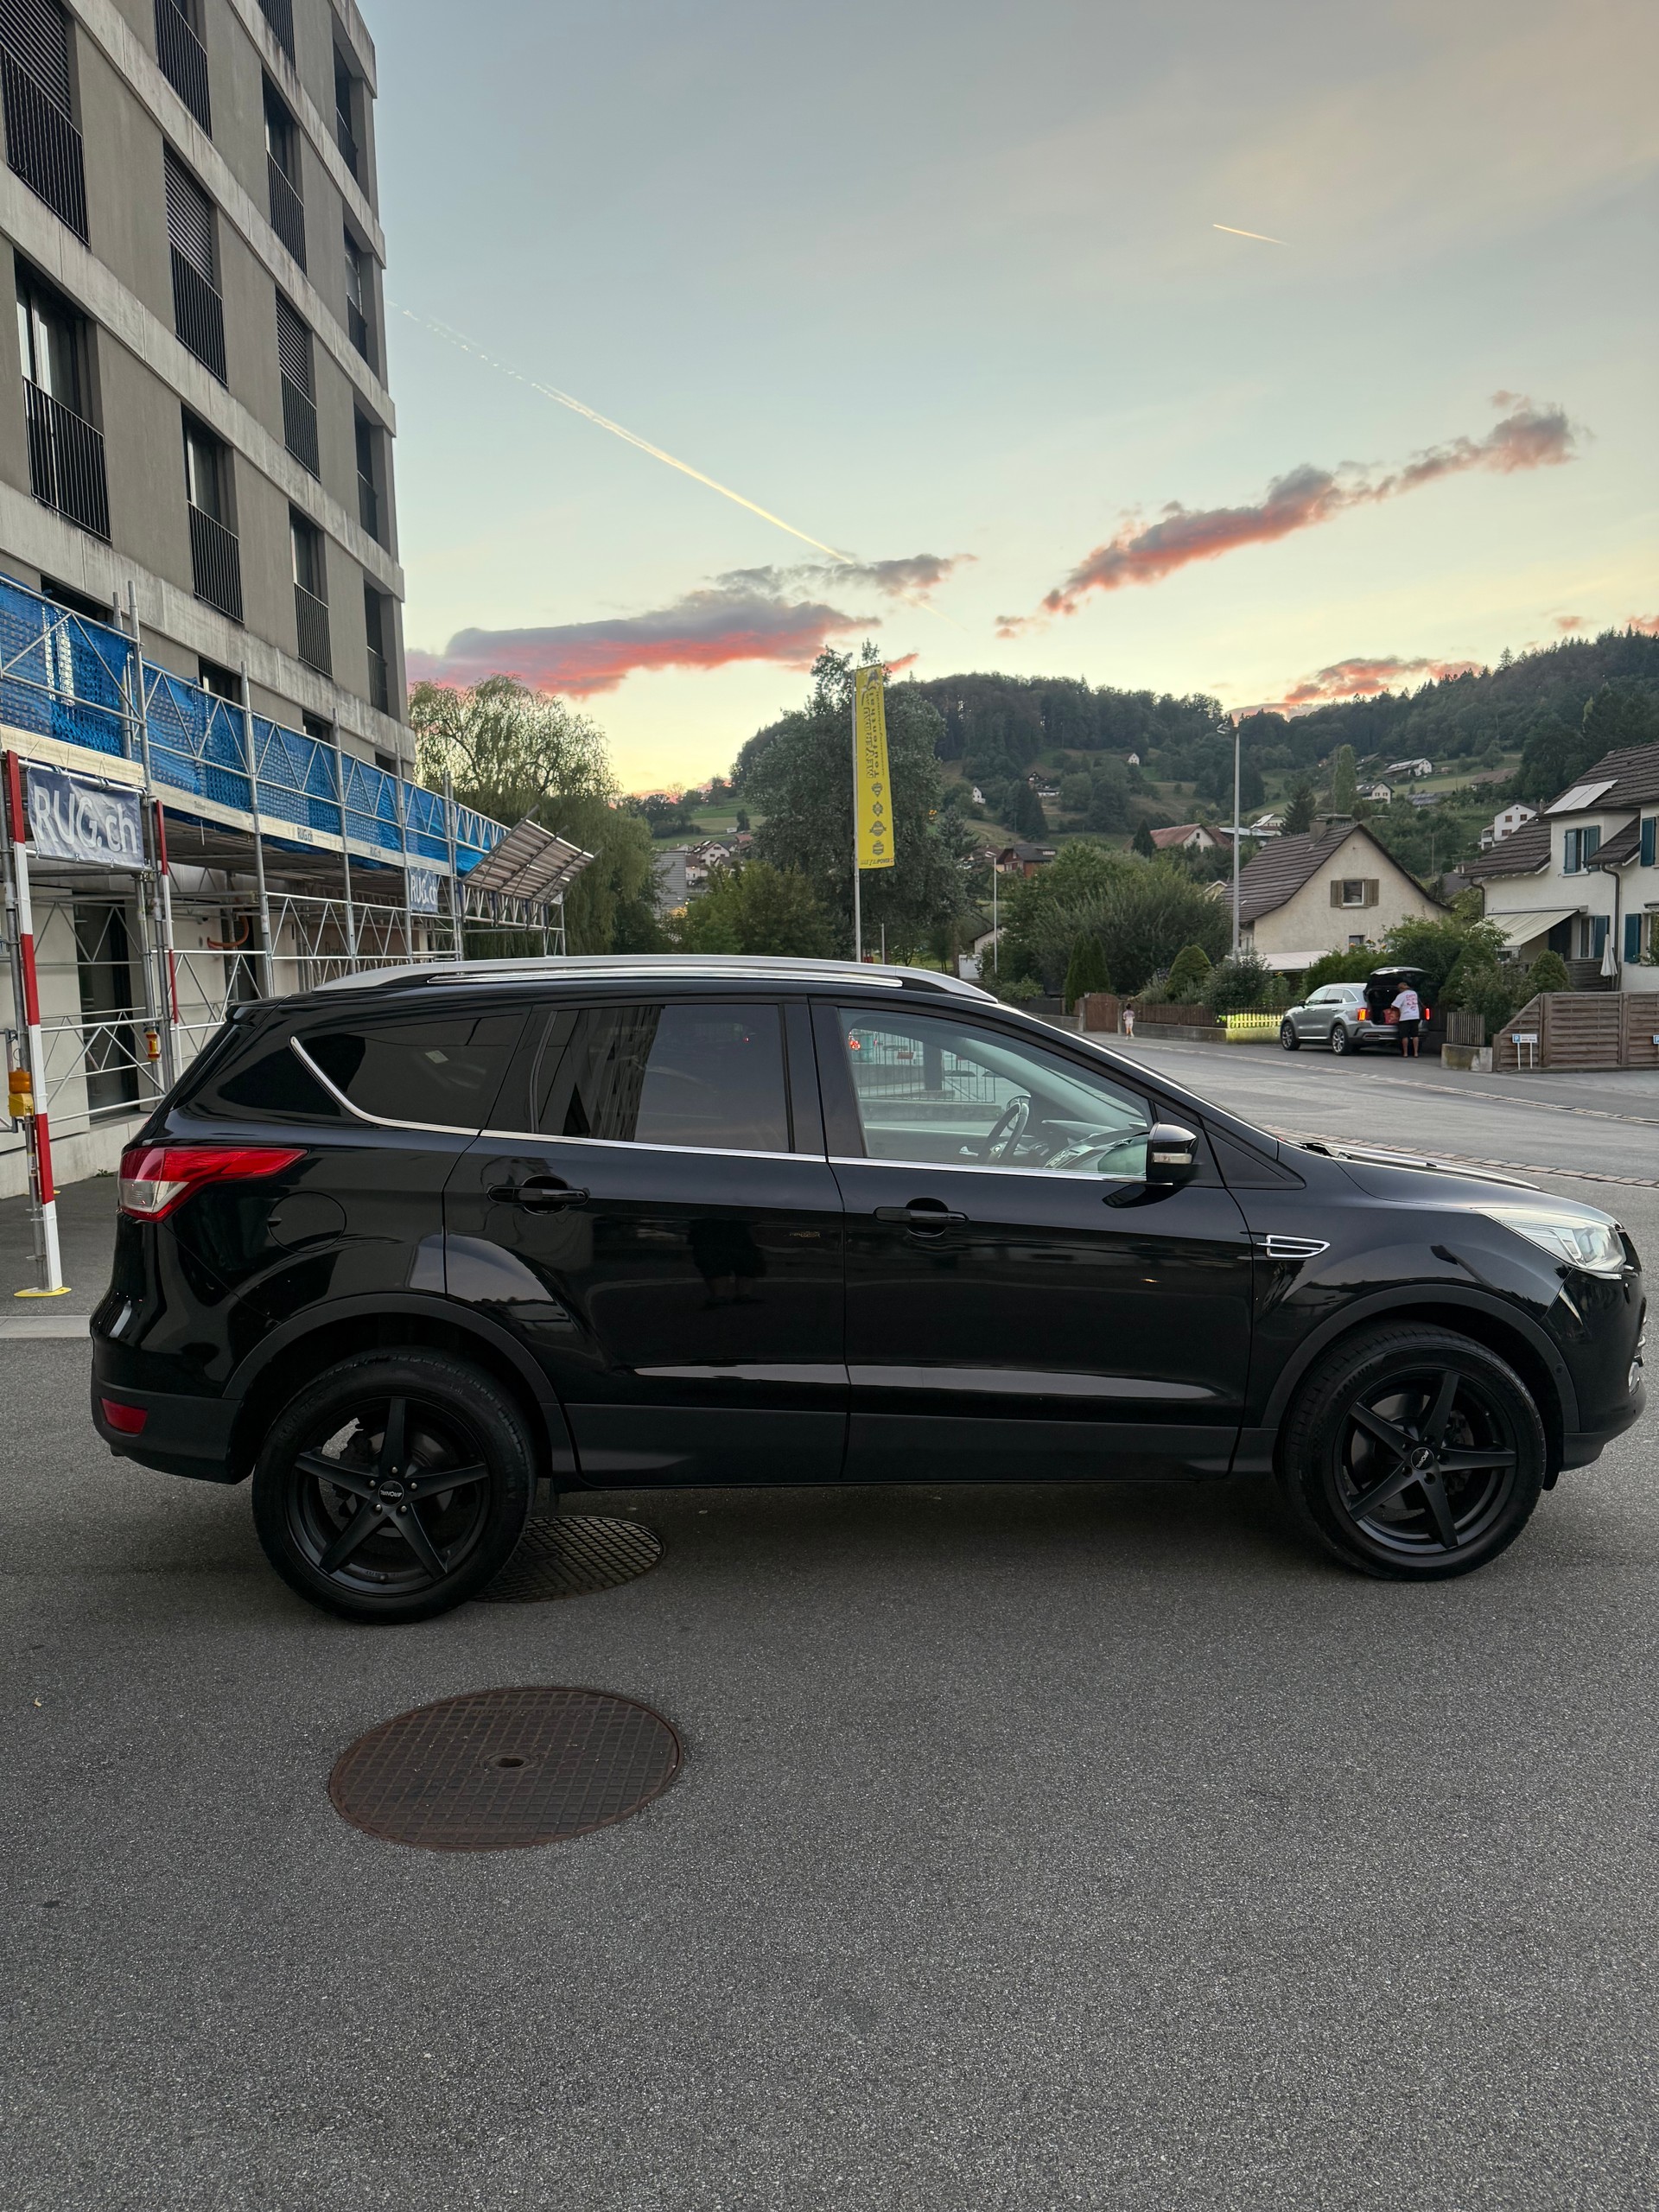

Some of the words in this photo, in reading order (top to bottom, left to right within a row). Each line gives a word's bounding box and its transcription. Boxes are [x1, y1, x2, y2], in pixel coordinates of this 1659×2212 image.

[865, 732, 874, 779] MEYER
[34, 785, 138, 854] RUG.ch
[410, 874, 438, 906] RUG.ch
